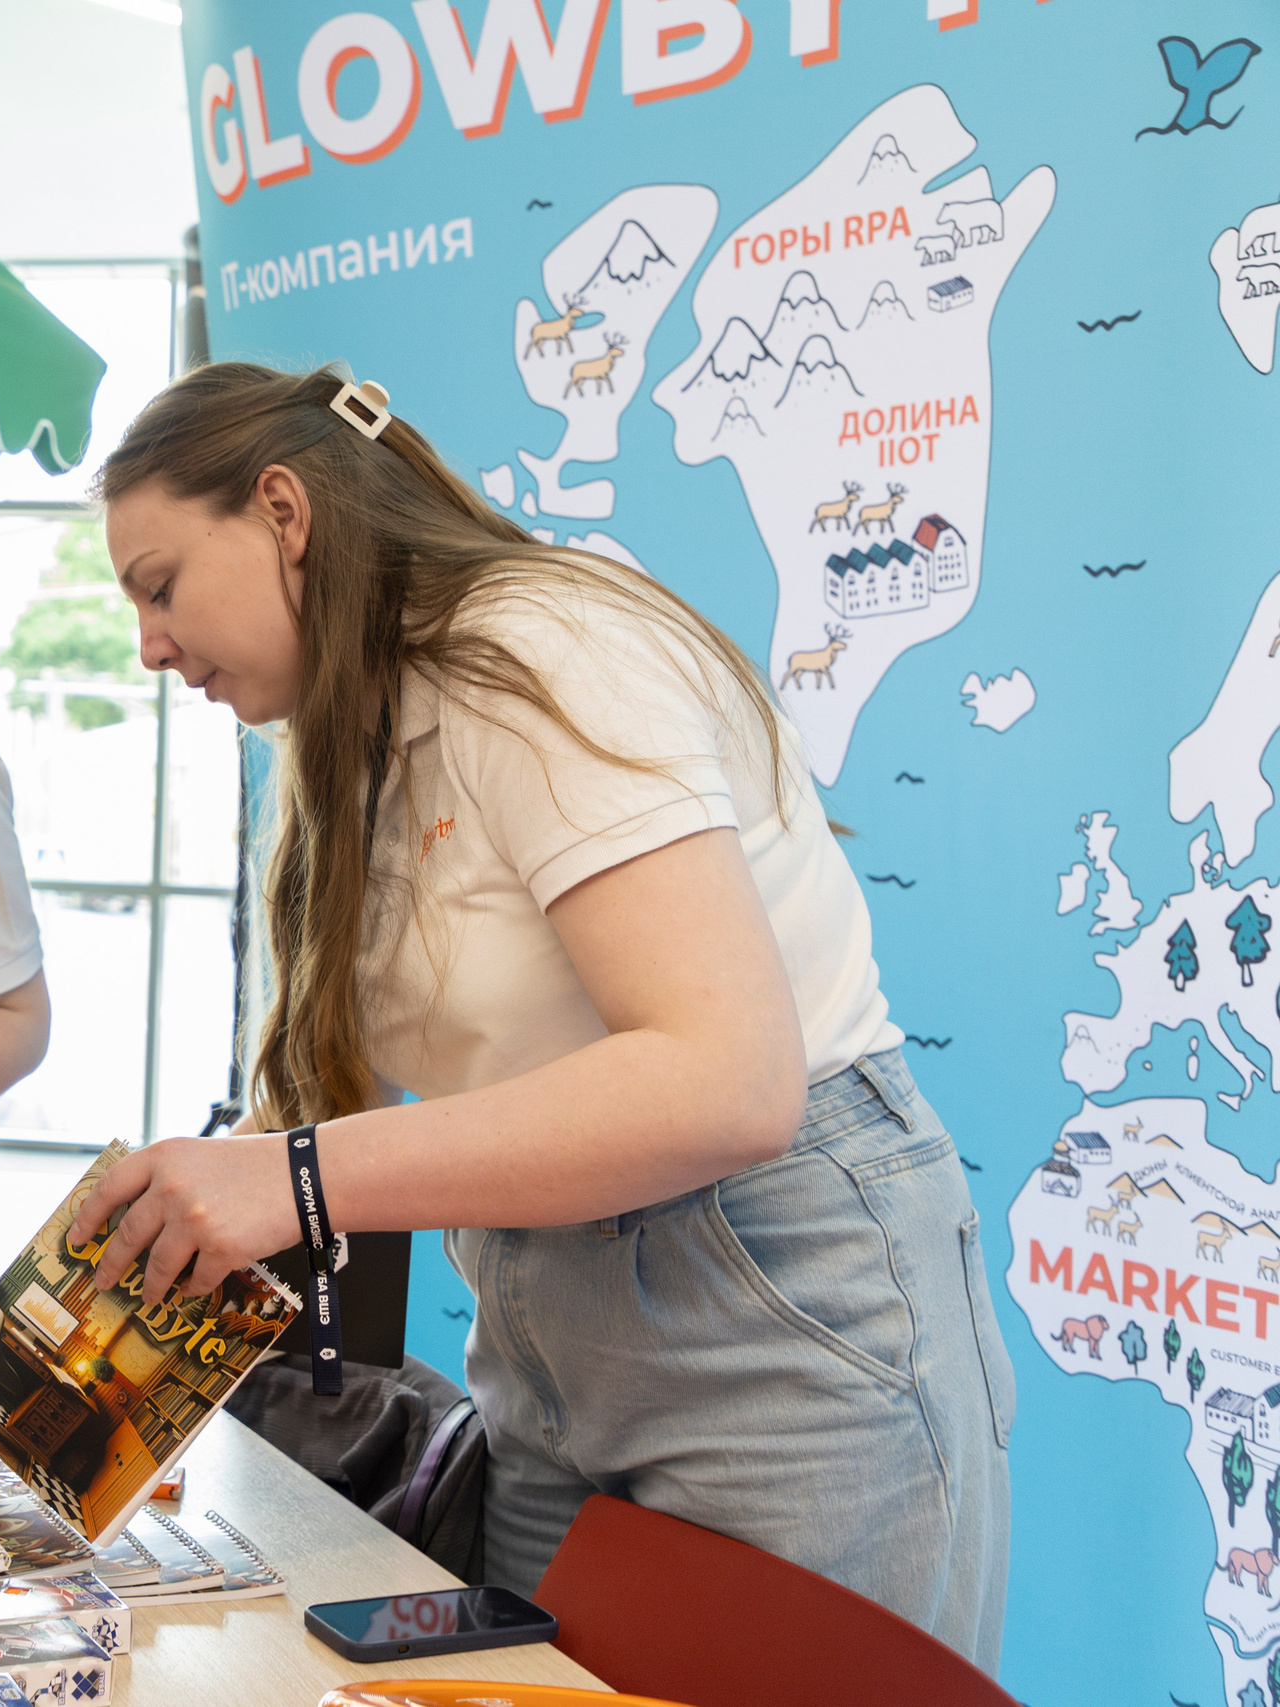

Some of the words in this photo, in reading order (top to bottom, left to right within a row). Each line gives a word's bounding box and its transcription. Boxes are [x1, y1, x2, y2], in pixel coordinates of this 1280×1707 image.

[201, 0, 978, 205] GLOWB
[220, 217, 475, 312] IT-компания
[733, 221, 830, 269] ГОРЫ
[844, 206, 912, 248] RPA
[838, 395, 980, 448] ДОЛИНА
[1133, 1159, 1168, 1182] ДЮНЫ
[1174, 1162, 1246, 1214] КЛИЕНТСКОЙ
[299, 1166, 317, 1213] ФОРУМ
[318, 1294, 330, 1325] ВШЭ
[1030, 1238, 1279, 1340] MARKET
[1210, 1348, 1271, 1374] CUSTOMER
